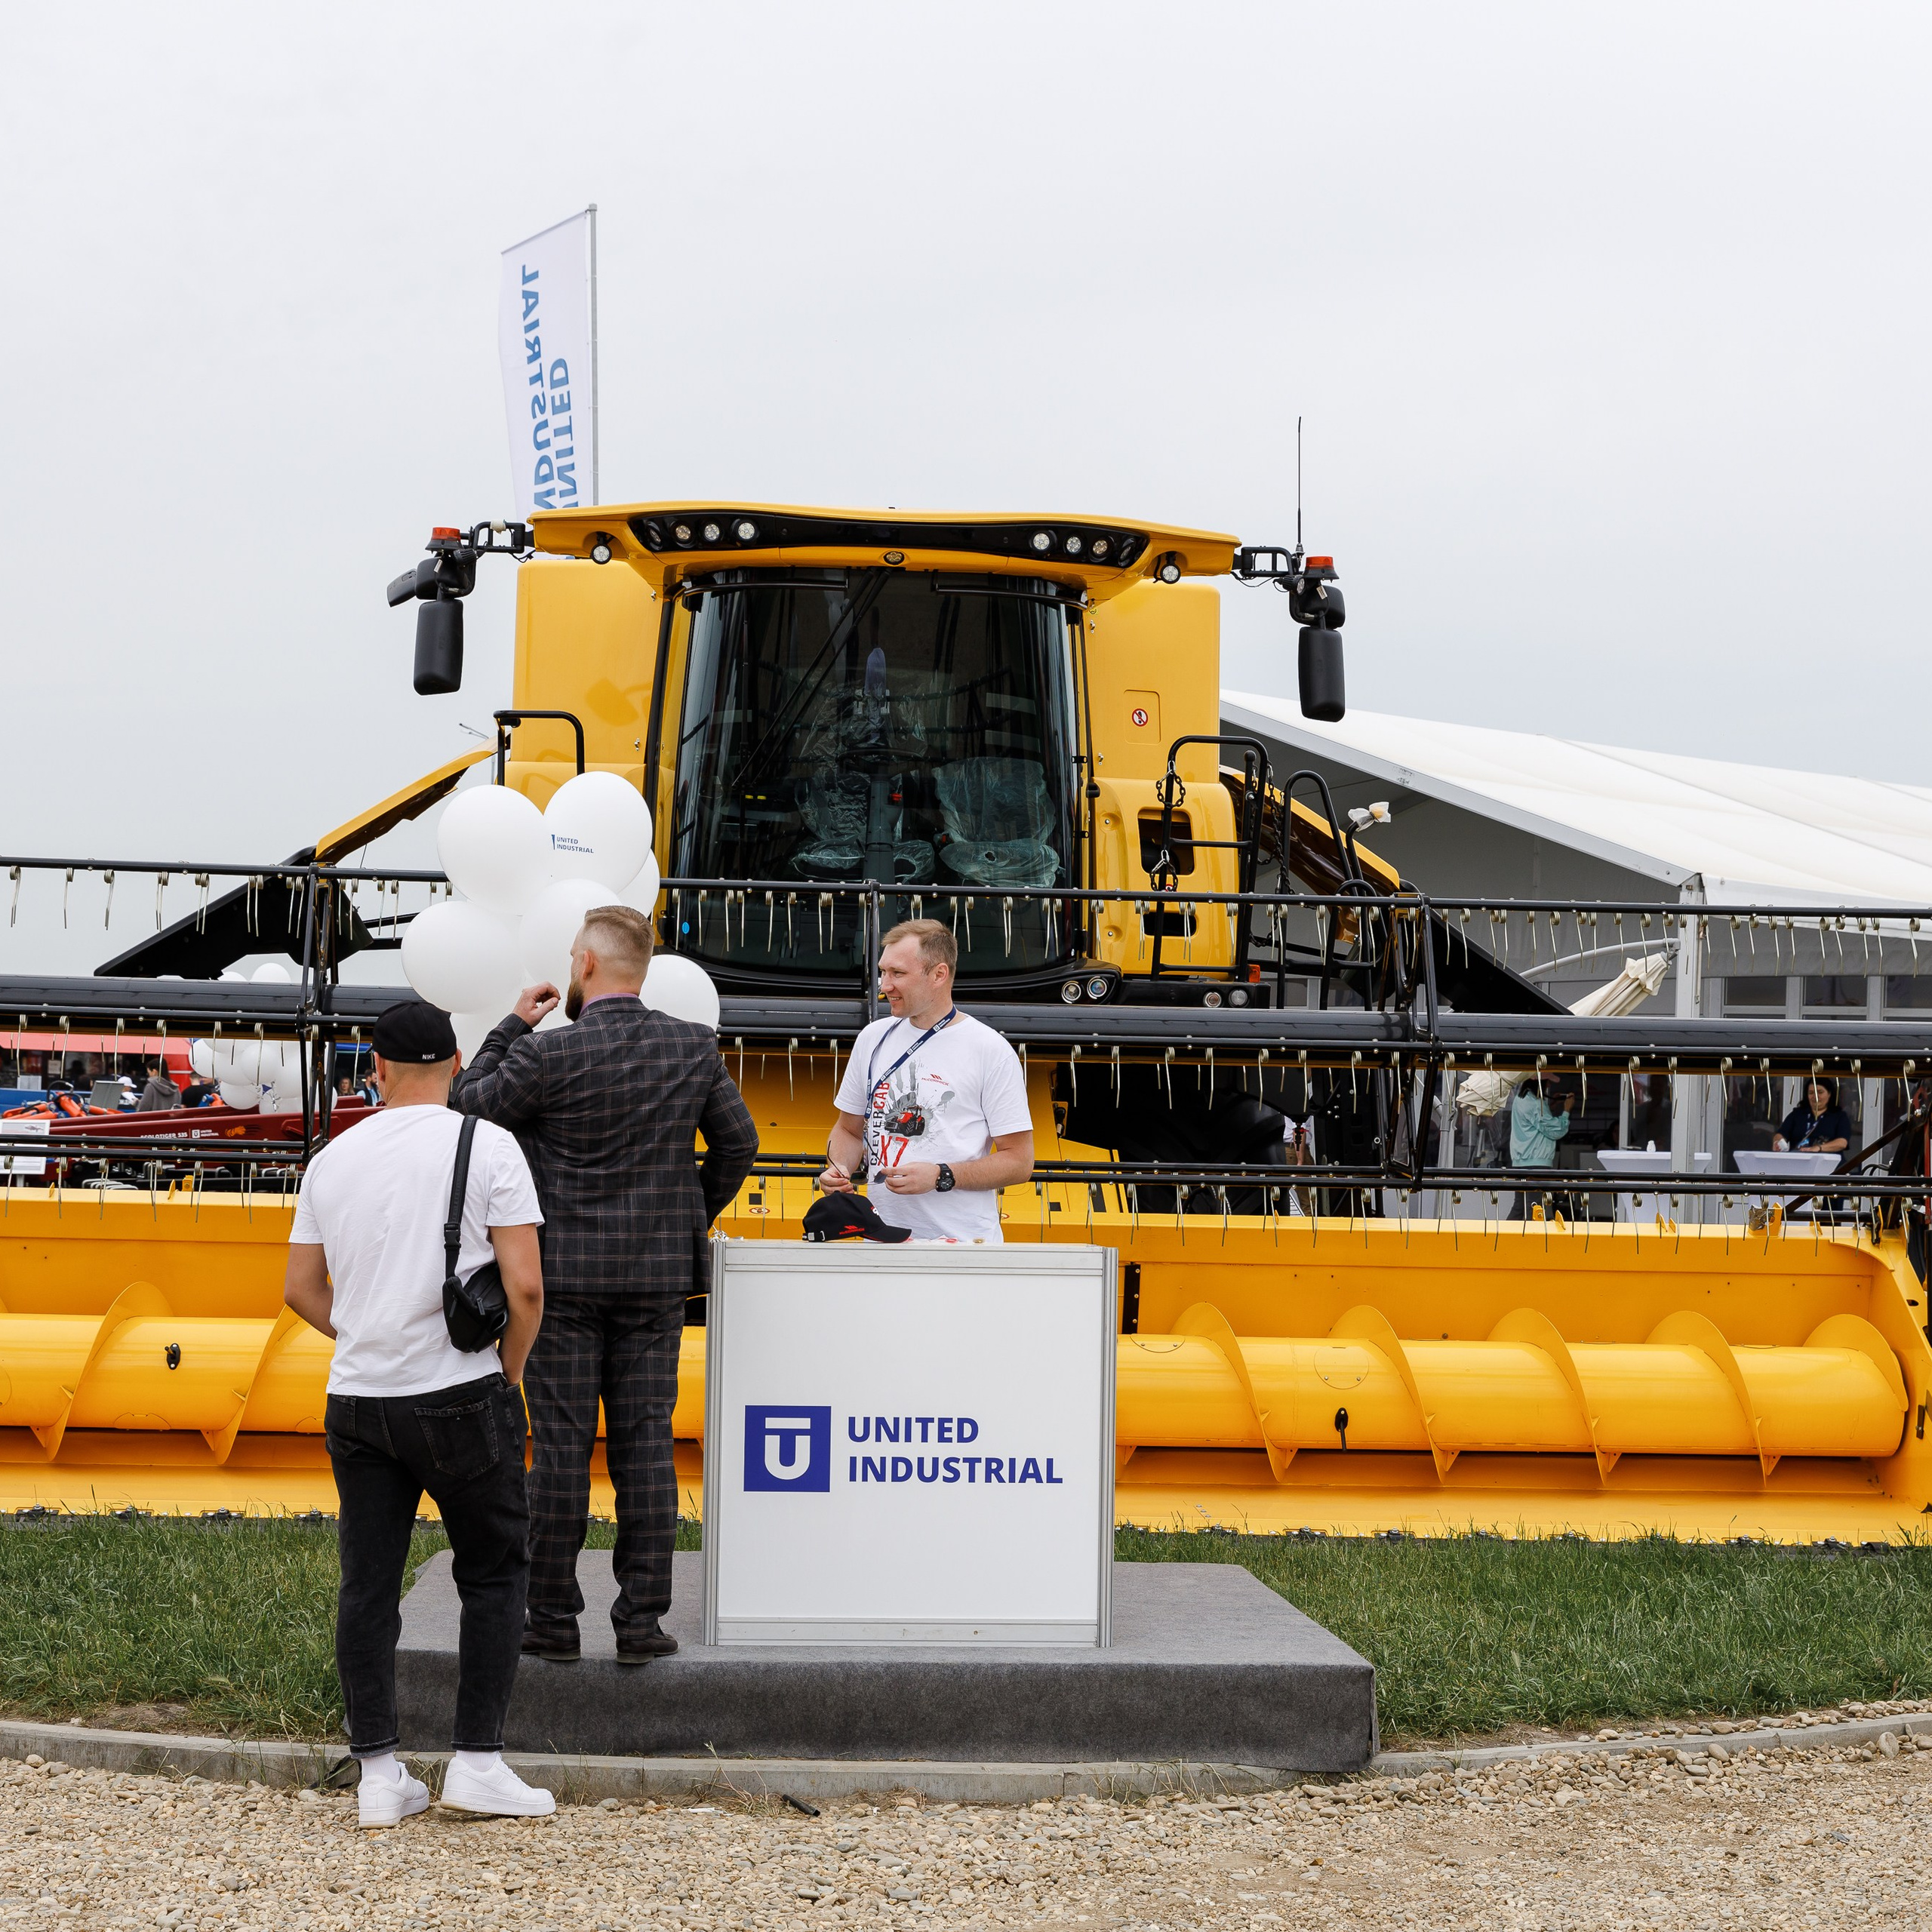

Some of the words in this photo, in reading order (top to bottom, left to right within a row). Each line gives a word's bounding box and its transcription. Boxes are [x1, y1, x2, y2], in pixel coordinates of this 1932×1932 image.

[556, 836, 579, 844] UNITED
[556, 844, 594, 854] INDUSTRIAL
[877, 1134, 910, 1168] X7
[848, 1417, 980, 1443] UNITED
[848, 1456, 1064, 1484] INDUSTRIAL
